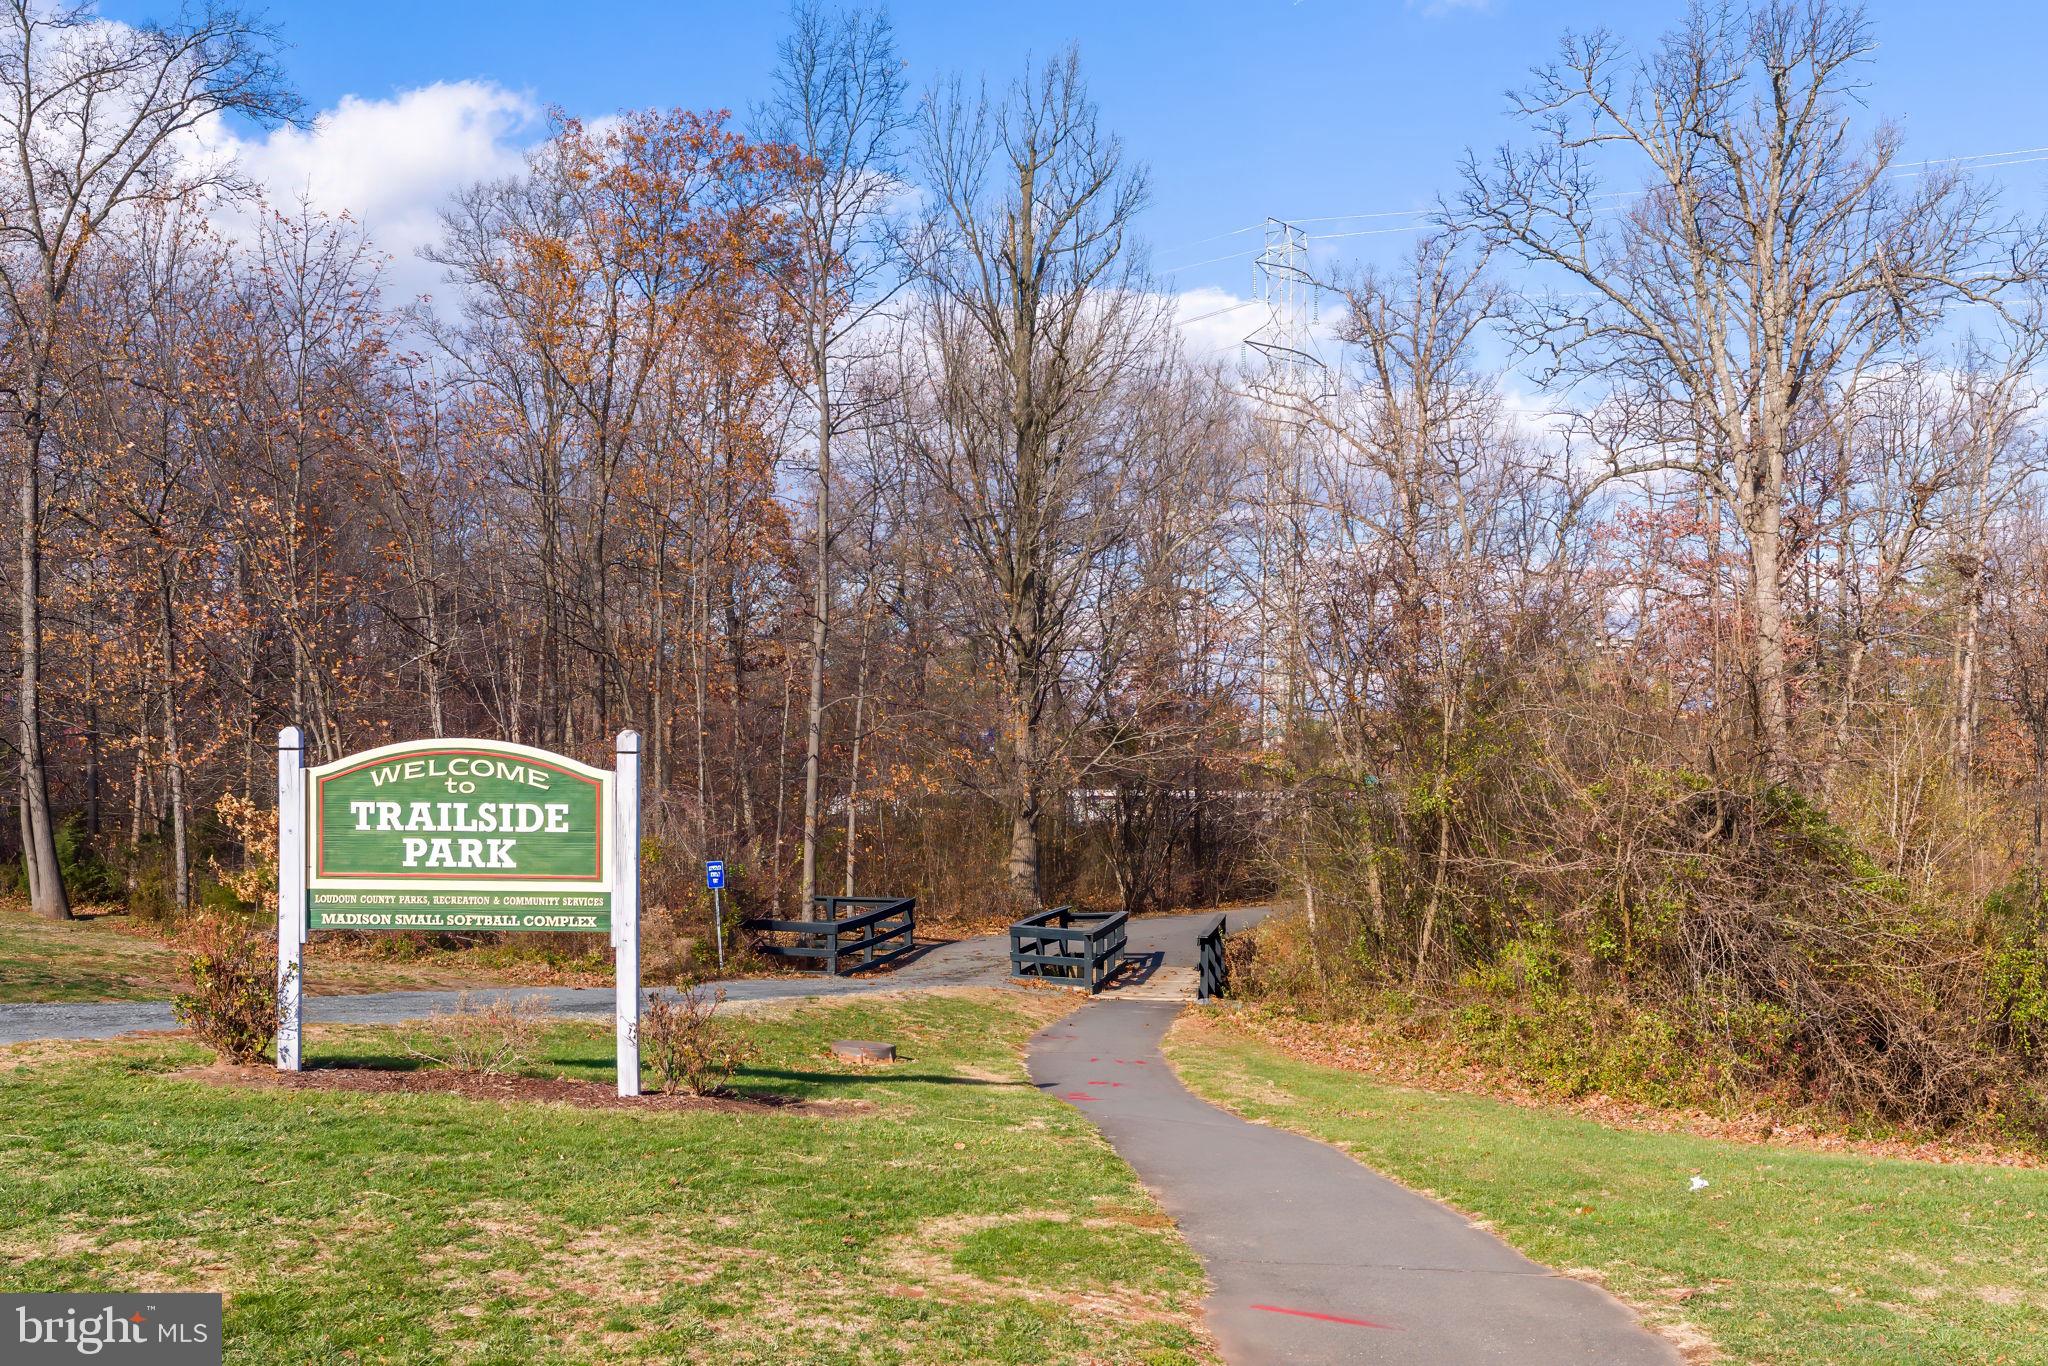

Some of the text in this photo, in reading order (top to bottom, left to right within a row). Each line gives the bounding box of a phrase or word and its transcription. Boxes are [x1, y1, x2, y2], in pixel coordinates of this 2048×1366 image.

[369, 758, 551, 790] WELCOME
[444, 778, 475, 794] to
[350, 801, 569, 833] TRAILSIDE
[402, 837, 517, 868] PARK
[315, 894, 604, 907] LOUDOUN COUNTY PARKS, RECREATION & COMMUNITY SERVICES
[321, 913, 598, 928] MADISON SMALL SOFTBALL COMPLEX
